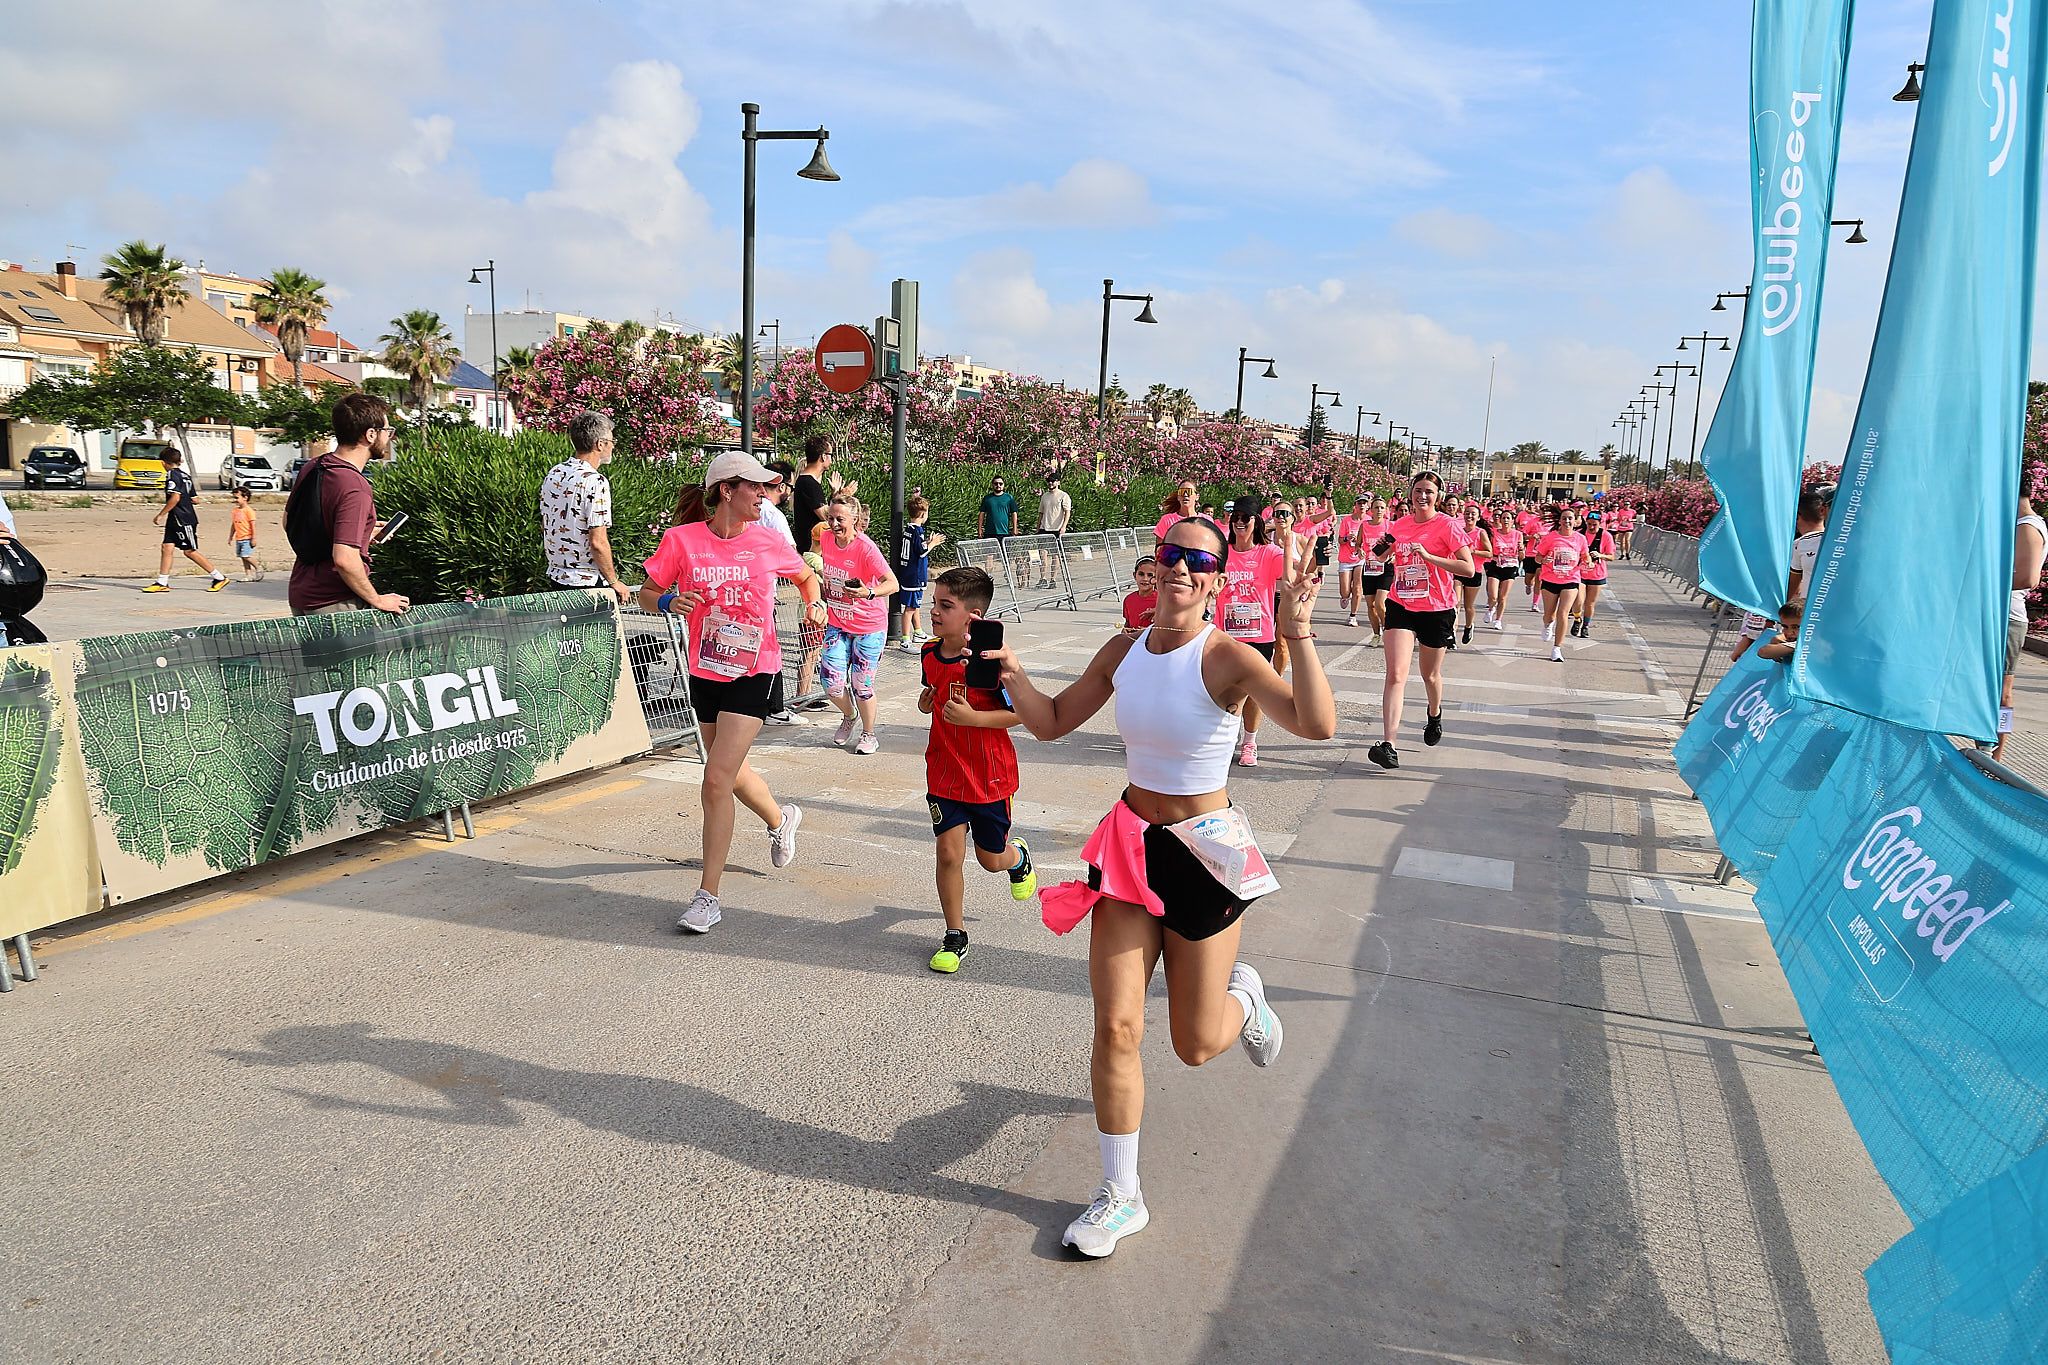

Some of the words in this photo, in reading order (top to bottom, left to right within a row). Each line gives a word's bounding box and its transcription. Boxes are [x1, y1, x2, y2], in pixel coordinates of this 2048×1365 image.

[692, 565, 750, 582] CARRERA
[725, 586, 743, 606] DE
[557, 639, 582, 657] 2026
[716, 643, 738, 657] 016
[146, 689, 192, 715] 1975
[312, 753, 404, 793] Cuidando
[407, 747, 429, 770] de
[432, 742, 444, 764] ti
[448, 735, 493, 759] desde
[495, 727, 528, 750] 1975
[1843, 805, 2011, 964] Compeed
[1848, 914, 1887, 966] AMPOLLAS
